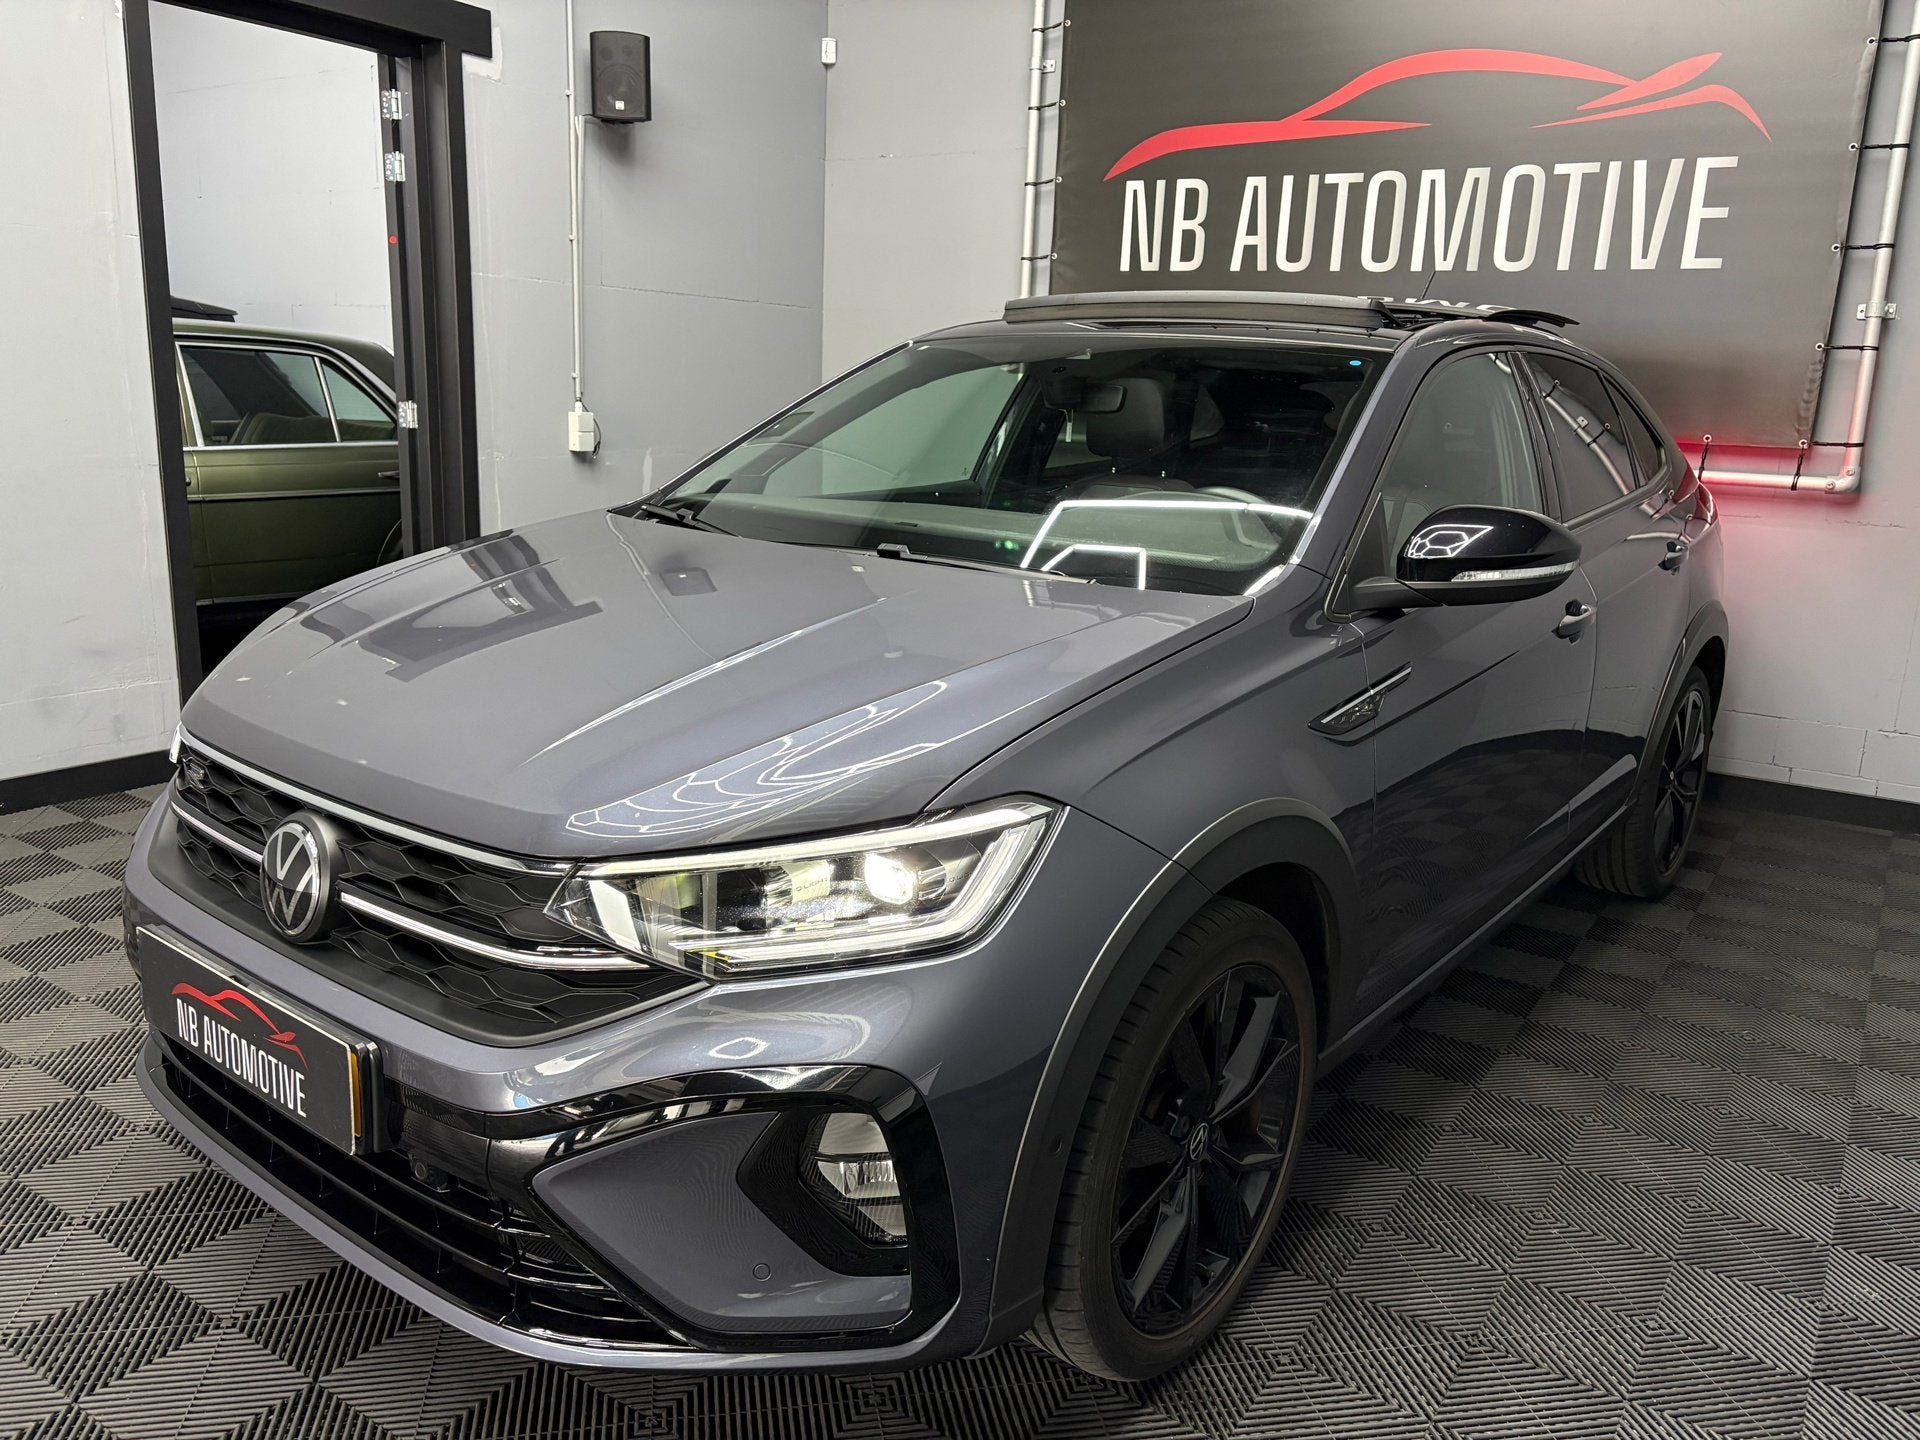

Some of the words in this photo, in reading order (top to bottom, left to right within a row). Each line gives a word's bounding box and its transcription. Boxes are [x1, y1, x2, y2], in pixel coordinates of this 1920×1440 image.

[1119, 178, 1209, 272] NB
[1229, 156, 1739, 272] AUTOMOTIVE
[176, 998, 199, 1048] NB
[203, 1014, 307, 1118] AUTOMOTIVE
